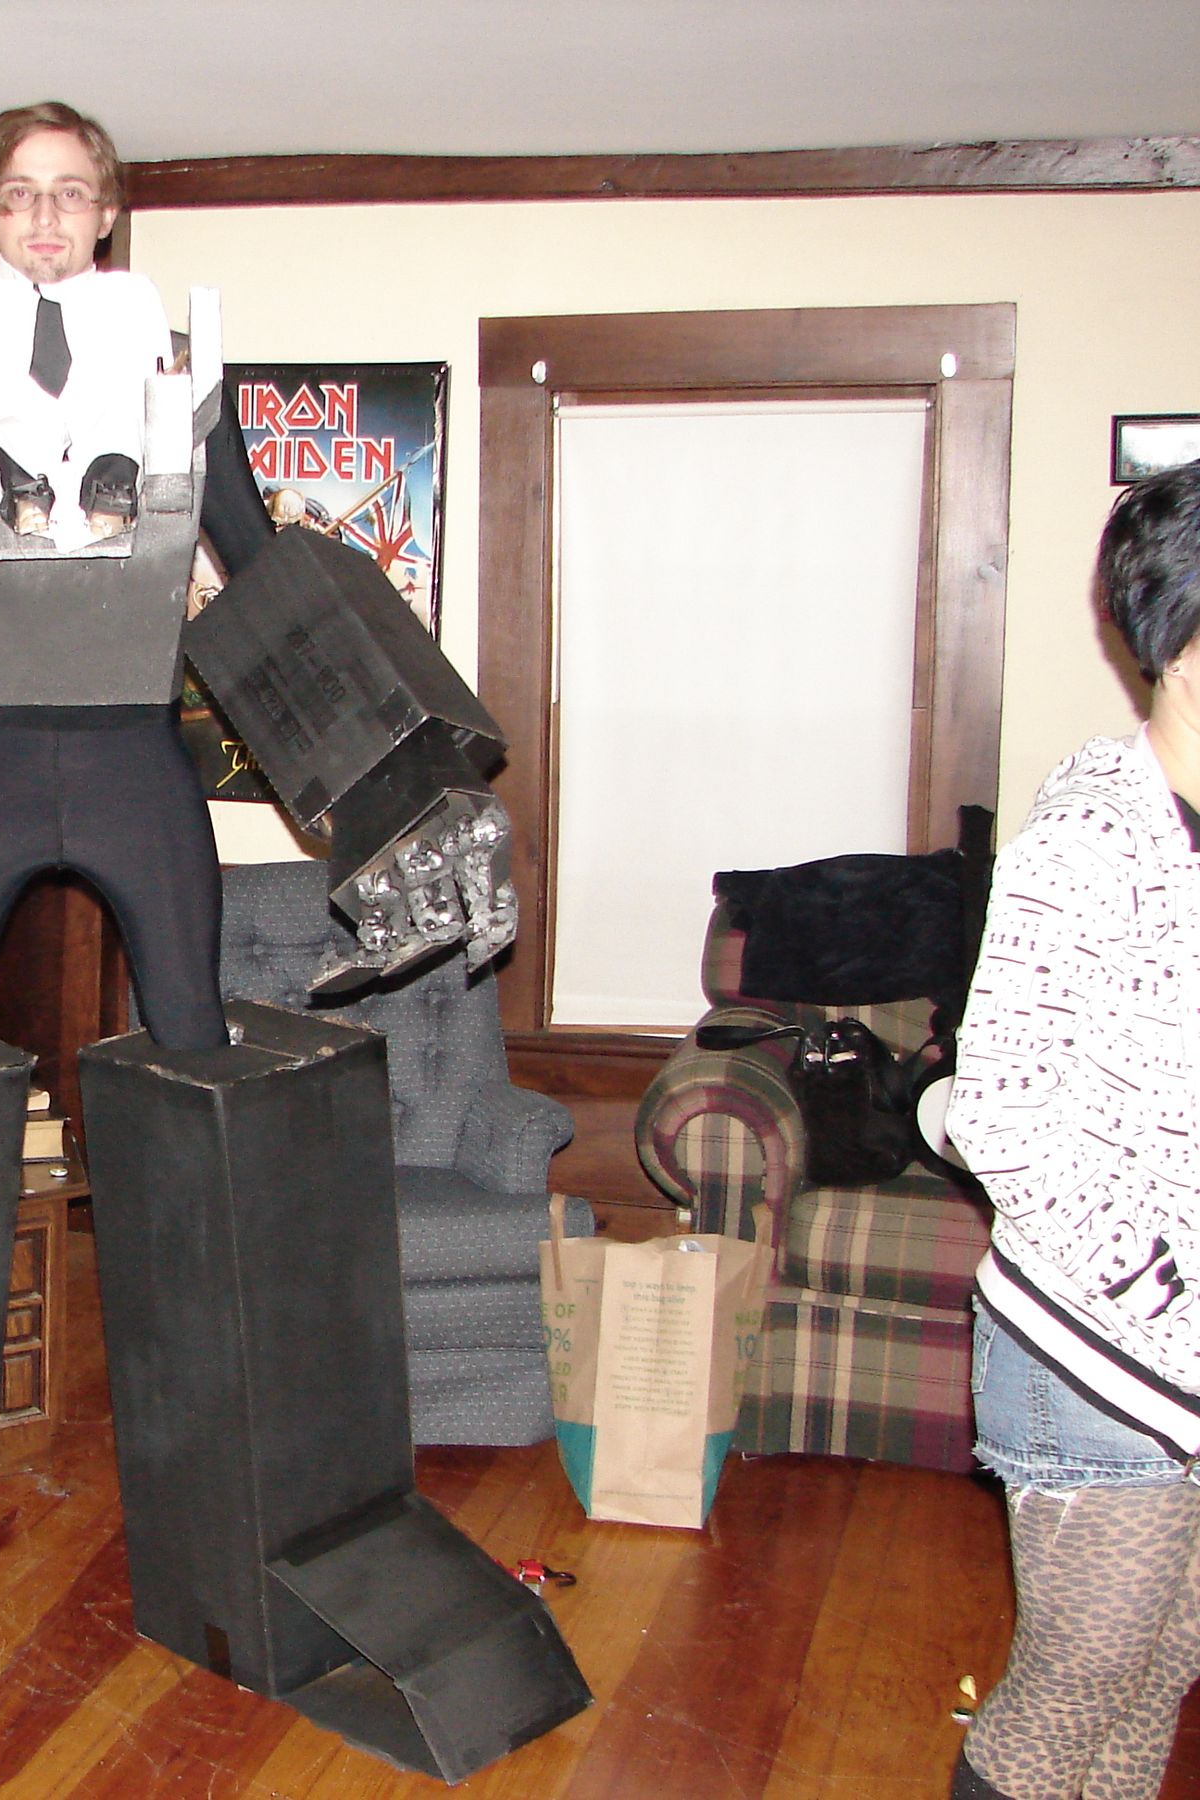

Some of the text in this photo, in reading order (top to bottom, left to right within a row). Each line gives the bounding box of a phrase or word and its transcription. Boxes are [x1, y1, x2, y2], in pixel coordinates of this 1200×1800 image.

[238, 382, 358, 438] IRON
[249, 437, 395, 486] AIDEN
[555, 1303, 576, 1318] OF
[736, 1333, 755, 1360] 10
